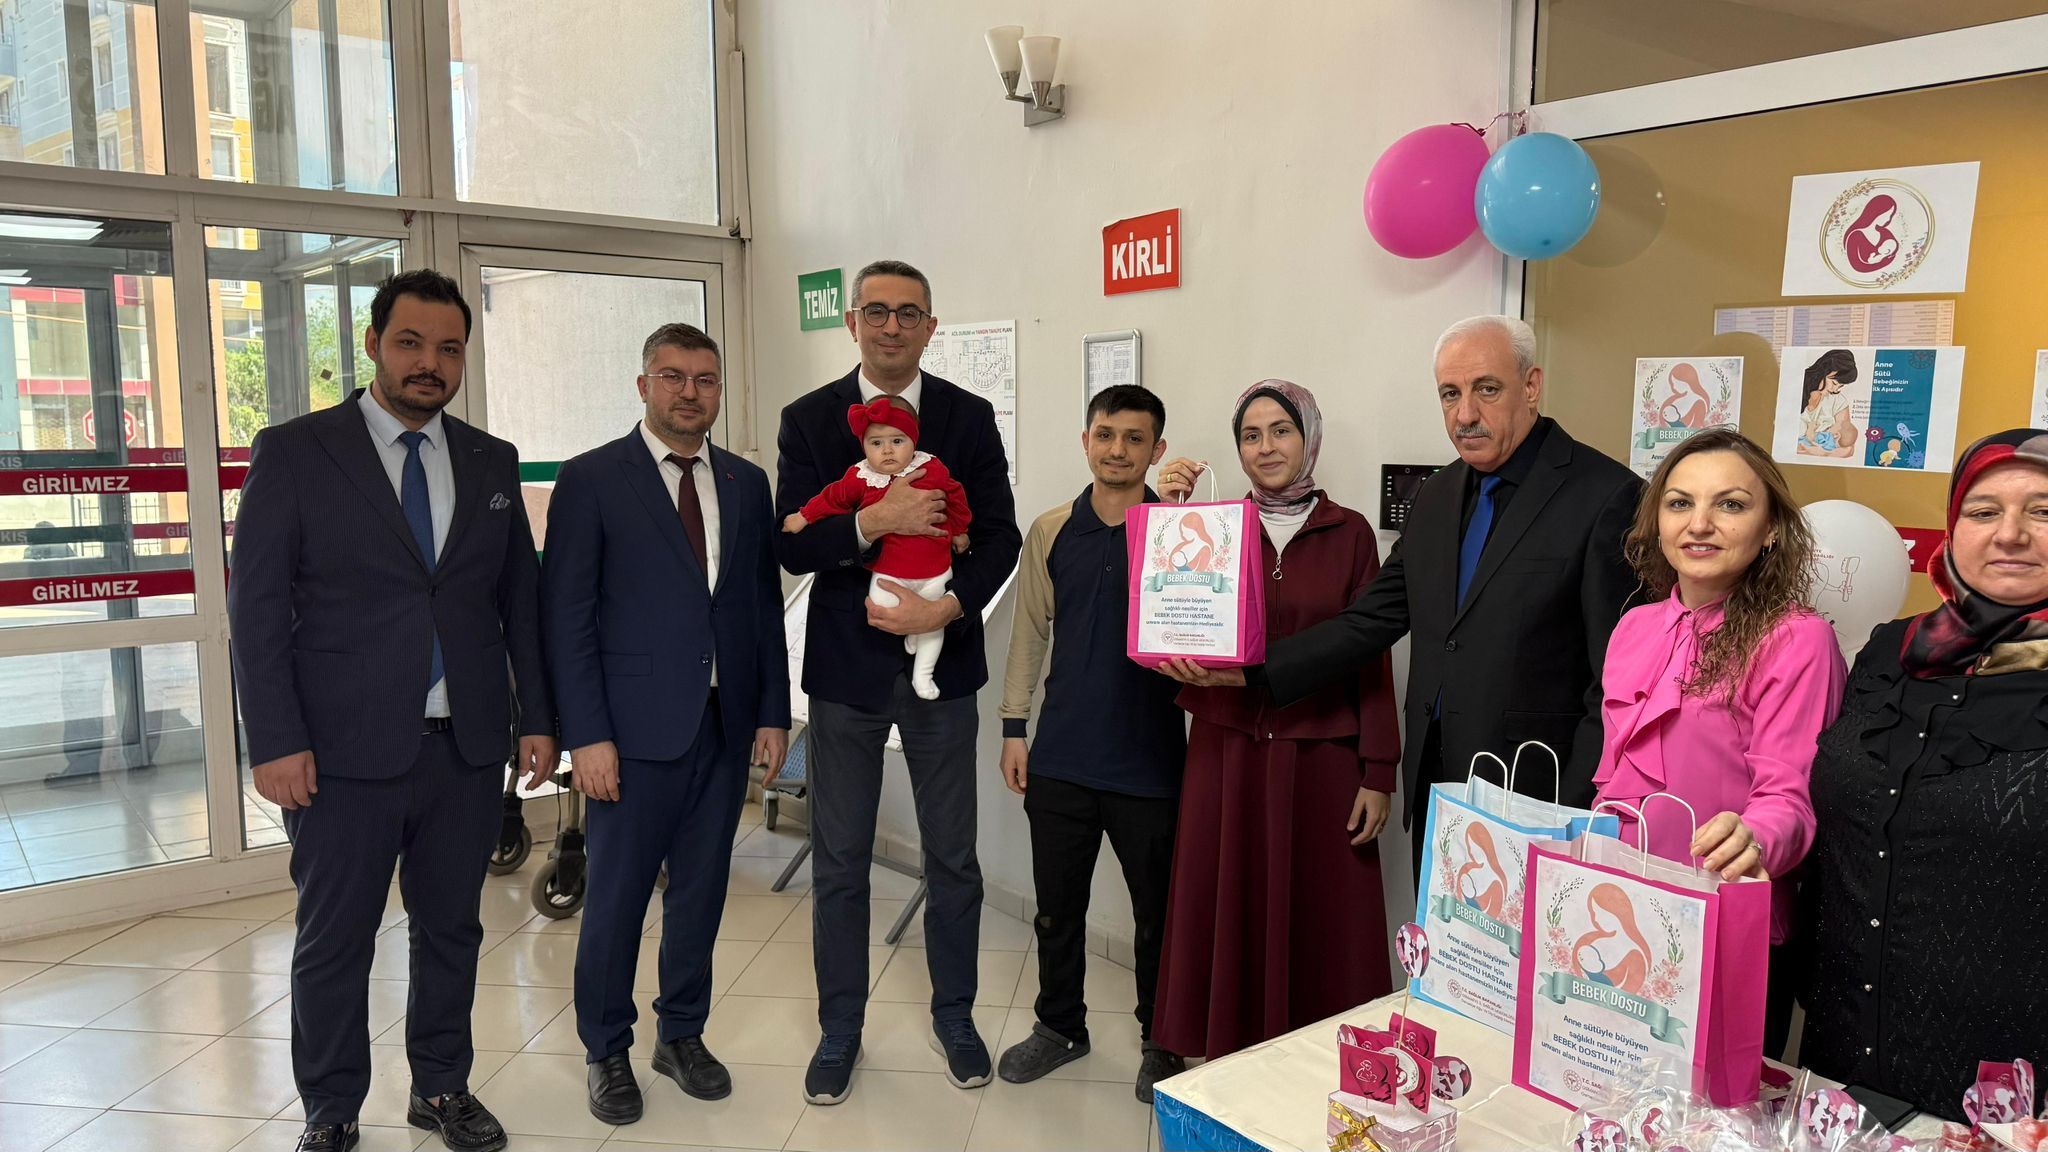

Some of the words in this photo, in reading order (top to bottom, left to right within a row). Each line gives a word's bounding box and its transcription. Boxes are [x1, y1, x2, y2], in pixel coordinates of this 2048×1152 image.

[1112, 225, 1172, 280] KİRLİ
[804, 282, 839, 320] TEMİZ
[1659, 430, 1682, 440] BEBEK
[22, 474, 130, 493] GİRİLMEZ
[32, 579, 140, 601] GİRİLMEZ
[1167, 574, 1186, 583] BEBEK
[1188, 574, 1211, 584] DOSTU
[1455, 903, 1478, 925] BEBEK
[1479, 915, 1505, 938] DOSTU
[1447, 932, 1460, 944] Anne
[1461, 941, 1483, 955] sütüyle
[1483, 950, 1510, 967] büyüyen
[1450, 947, 1470, 959] sağlıklı
[1471, 957, 1493, 970] nesiller
[1494, 966, 1505, 977] için
[1438, 949, 1458, 964] BEBEK
[1459, 959, 1481, 974] DOSTU
[1482, 970, 1513, 990] HASTANE
[1572, 981, 1607, 1003] BEBEK
[1610, 992, 1647, 1018] DOSTU
[1553, 1033, 1577, 1051] BEBEK
[1578, 1045, 1608, 1062] DOSTU
[1563, 1015, 1582, 1028] Anne
[1583, 1023, 1614, 1038] sütüyle
[1615, 1032, 1649, 1052] büyüyen
[1569, 1031, 1595, 1046] sağlıklı
[1597, 1041, 1626, 1057] nesiller
[1627, 1050, 1642, 1063] için
[1541, 1041, 1561, 1055] unvanı
[1562, 1051, 1576, 1062] alan
